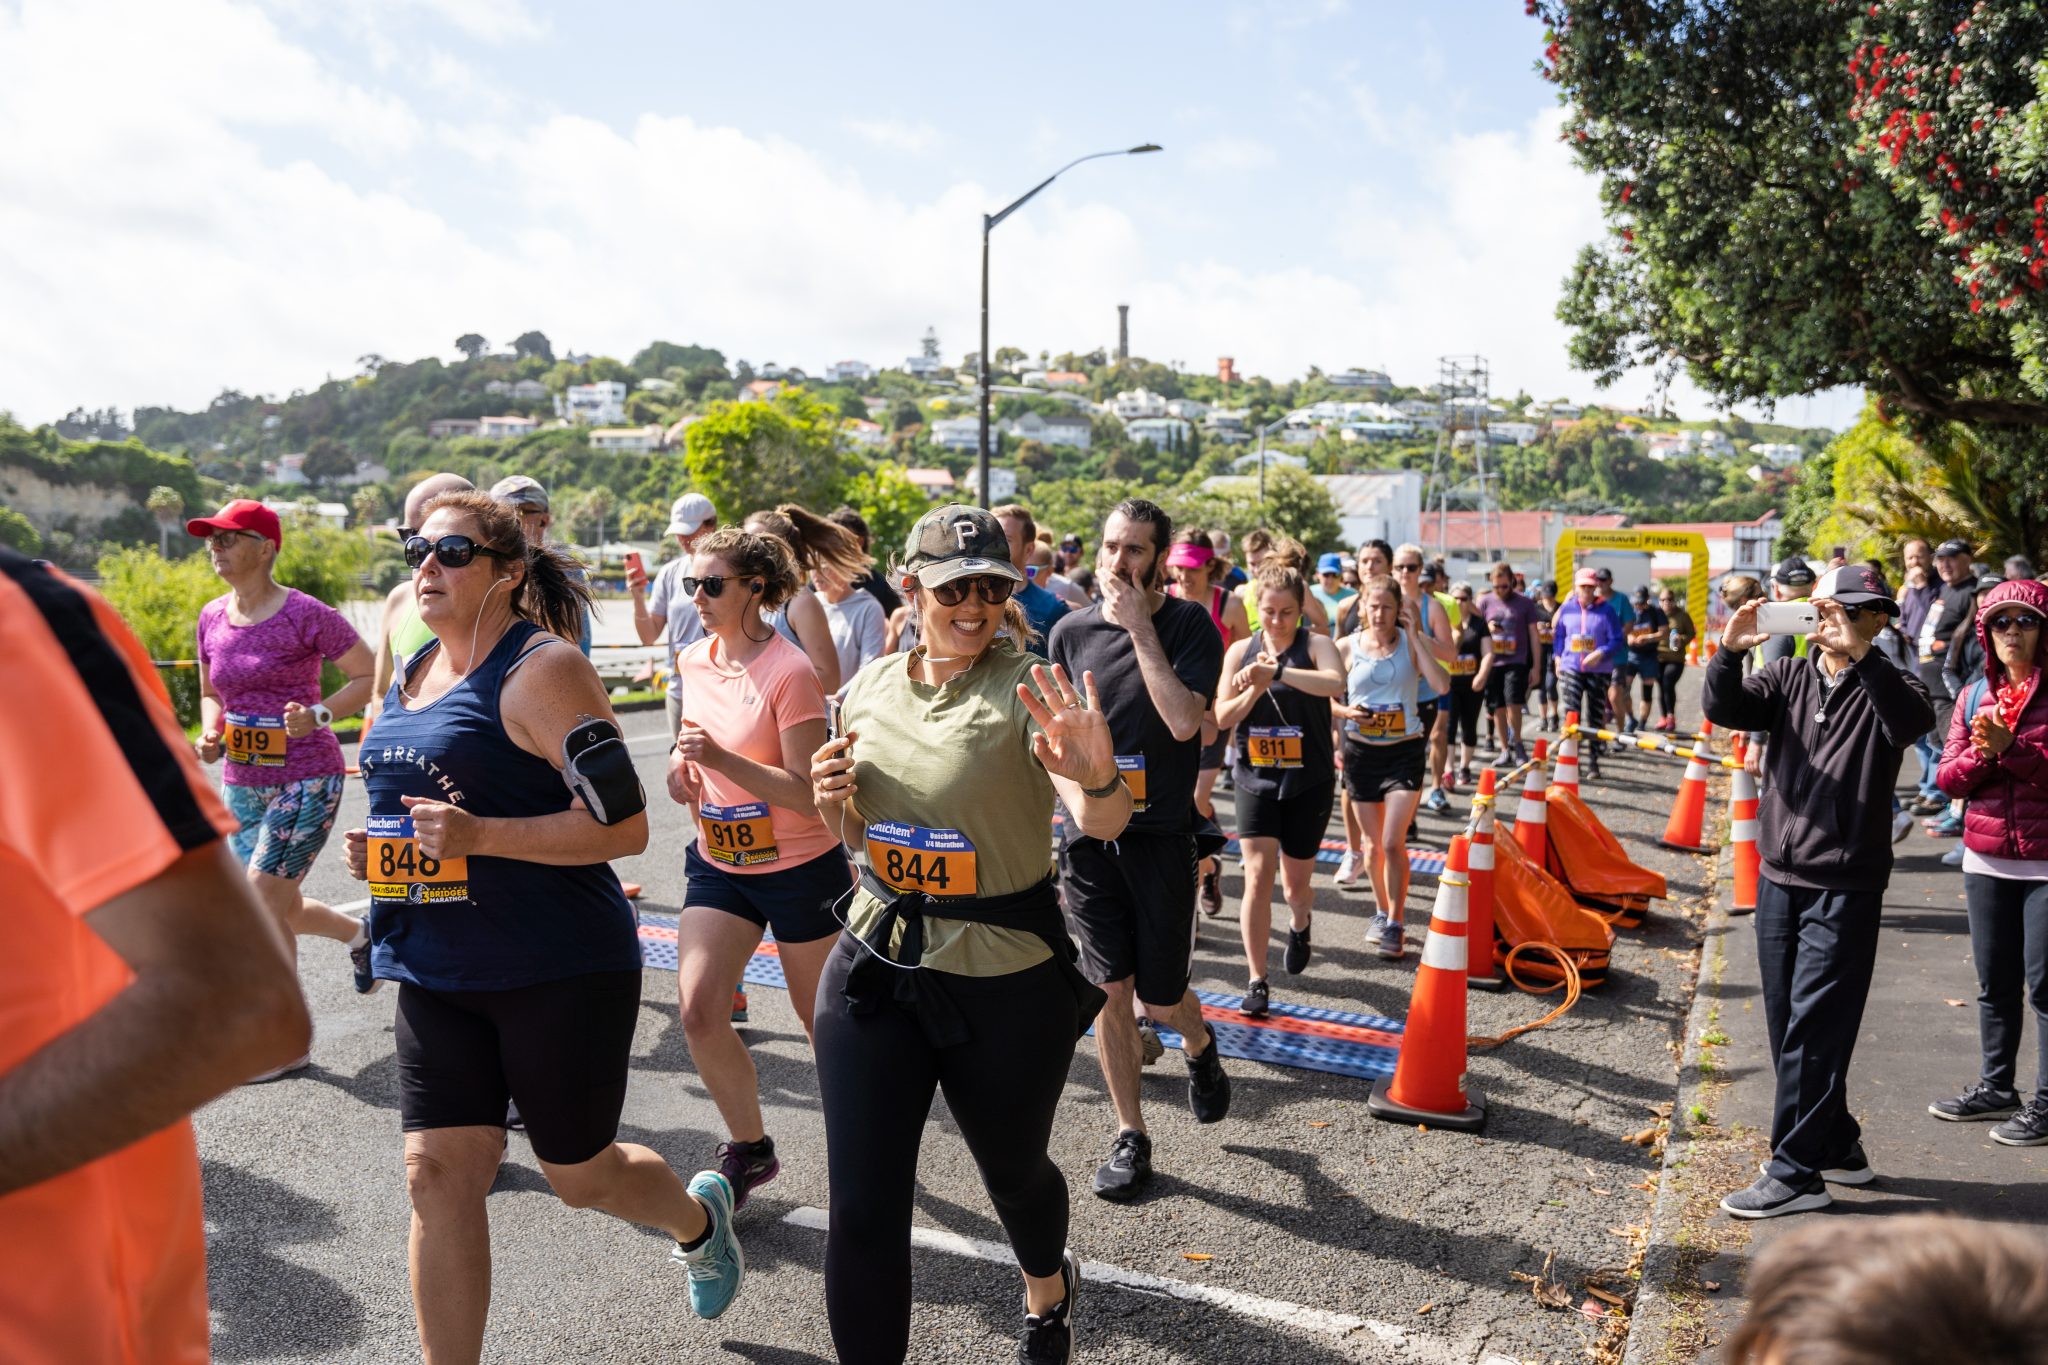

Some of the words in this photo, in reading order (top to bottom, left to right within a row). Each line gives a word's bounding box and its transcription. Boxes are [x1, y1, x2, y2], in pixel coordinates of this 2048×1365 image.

[953, 521, 980, 550] P
[1644, 536, 1689, 546] FINISH
[1369, 713, 1396, 727] 57
[232, 728, 270, 751] 919
[1260, 739, 1286, 756] 811
[383, 745, 465, 804] BREATHE
[367, 817, 401, 829] Unichem
[712, 823, 755, 848] 918
[929, 832, 959, 840] Unichem
[925, 840, 935, 848] 1/4
[935, 841, 965, 849] Marathon
[380, 842, 441, 877] 848
[887, 849, 951, 889] 844
[422, 891, 430, 903] 3
[430, 889, 468, 898] BRIDGES
[429, 896, 468, 904] MARATHON
